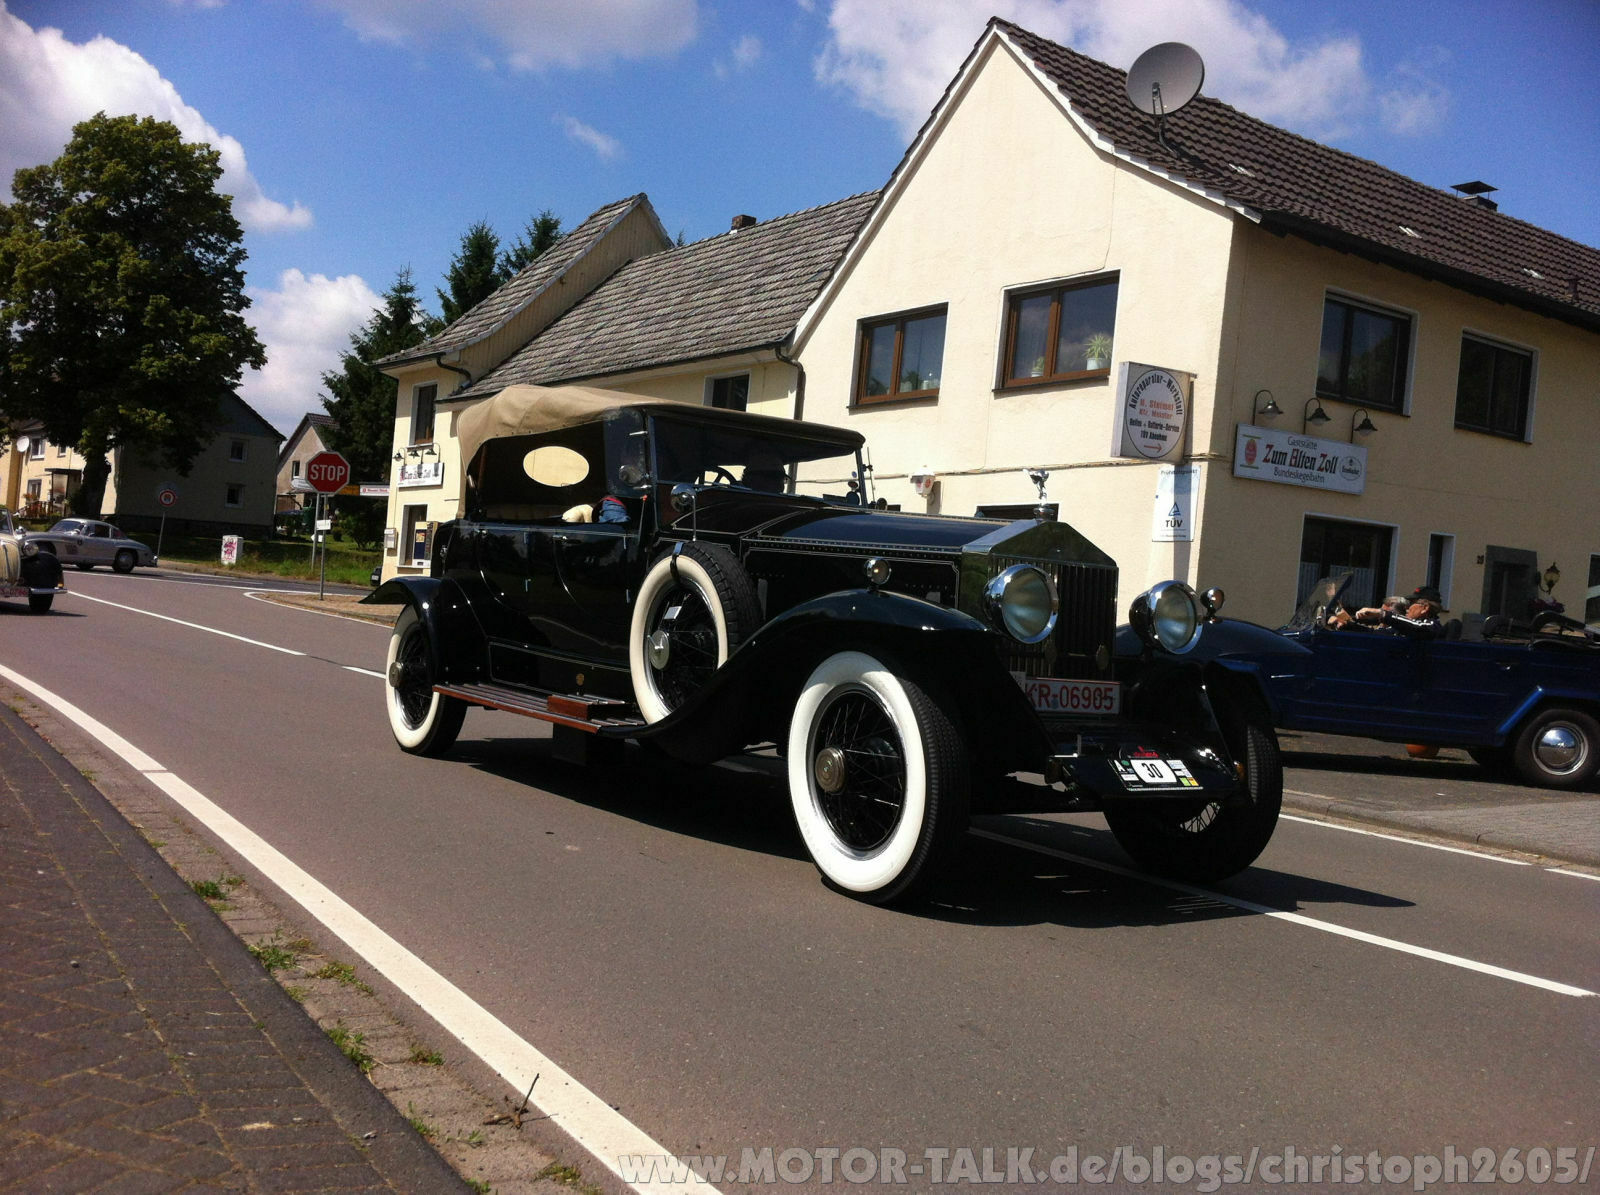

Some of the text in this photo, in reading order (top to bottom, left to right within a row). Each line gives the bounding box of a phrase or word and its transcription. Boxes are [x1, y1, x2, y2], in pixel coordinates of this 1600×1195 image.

[1287, 435, 1318, 450] Gaststätte
[1262, 443, 1339, 474] Zum Alten Zoll
[310, 464, 345, 482] STOP
[1273, 466, 1325, 484] Bundeskegelbahn
[1165, 517, 1183, 528] TÜV
[1141, 762, 1164, 779] 30
